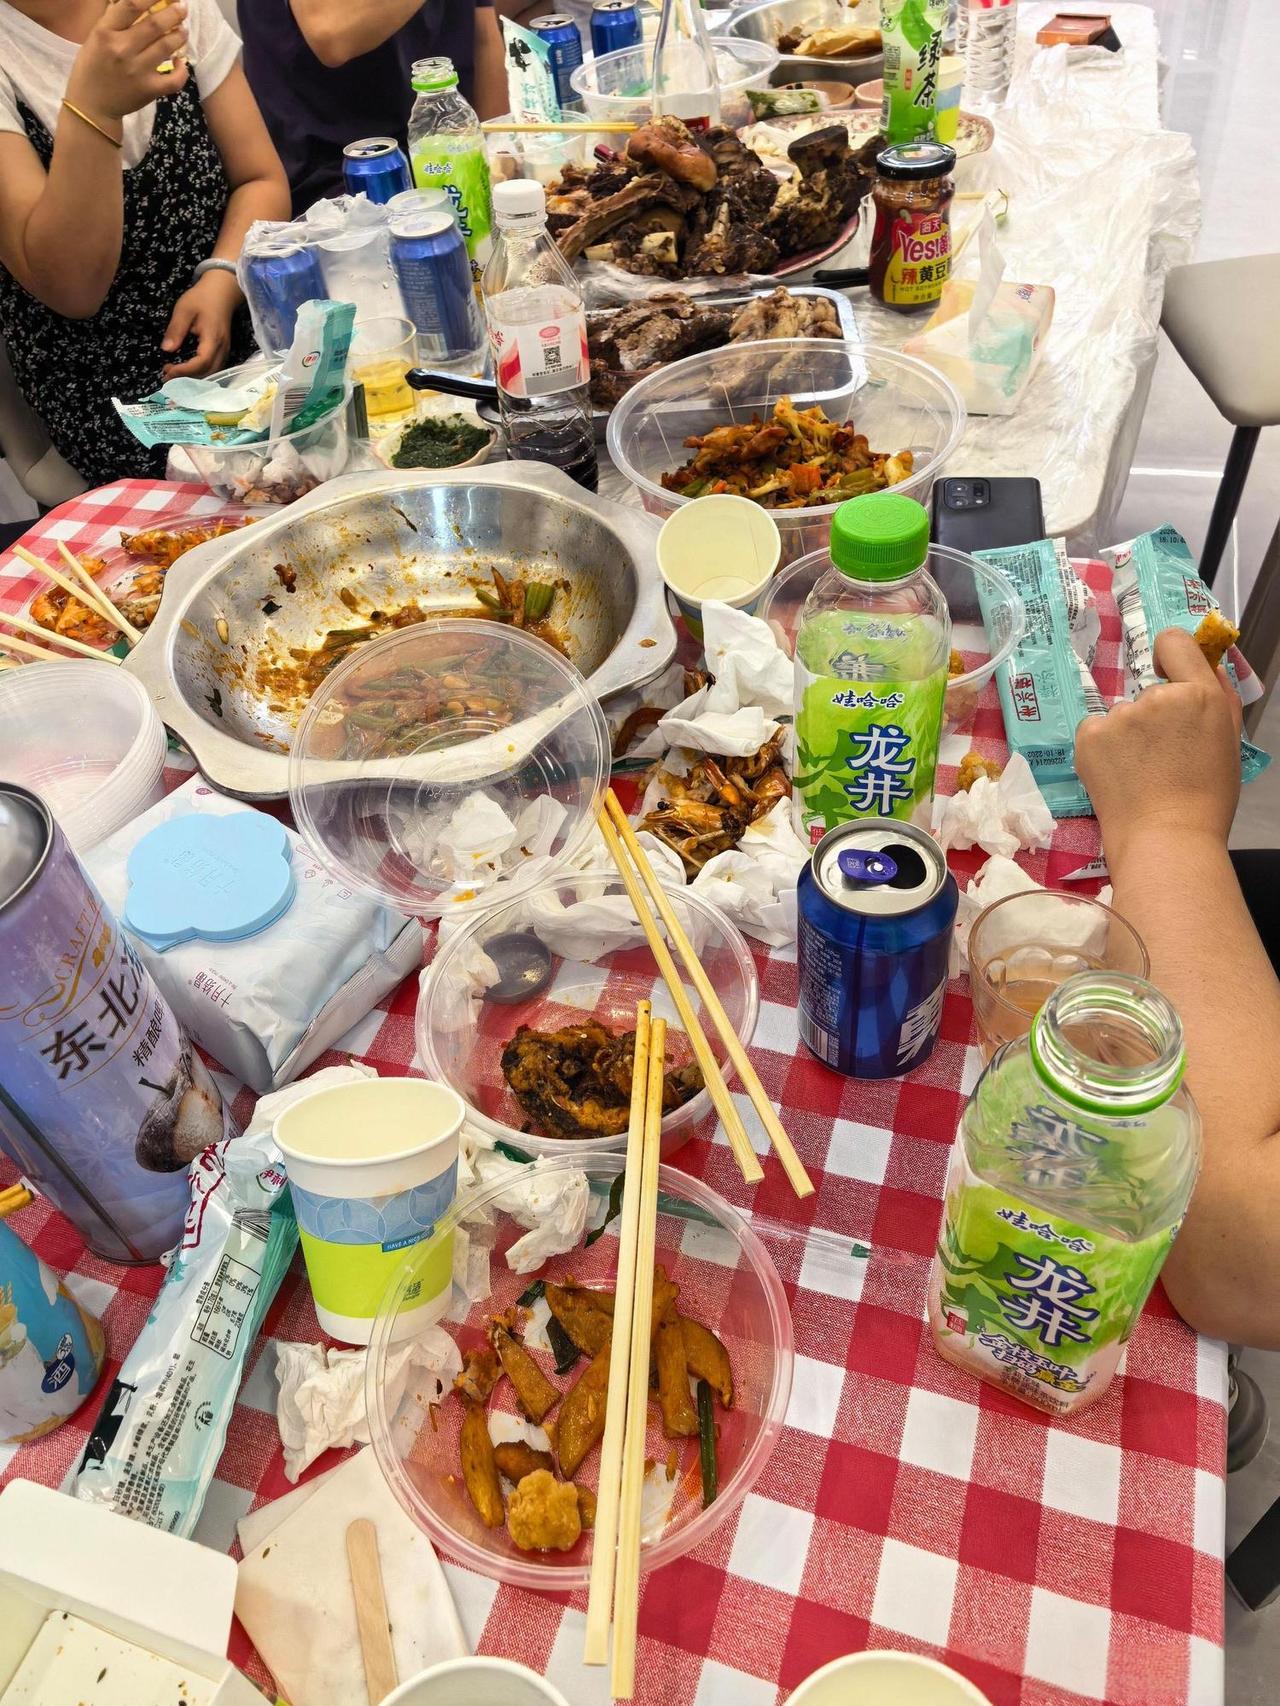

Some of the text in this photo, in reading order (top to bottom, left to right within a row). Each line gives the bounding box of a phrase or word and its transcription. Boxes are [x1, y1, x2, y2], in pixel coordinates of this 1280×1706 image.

[914, 30, 942, 107] 绿茶
[424, 163, 452, 174] 娃哈哈
[832, 690, 903, 708] 娃哈哈
[845, 724, 916, 816] 龙井
[194, 971, 232, 1008] 十月结晶
[997, 1208, 1092, 1253] 娃哈哈
[998, 1252, 1100, 1347] 龙井
